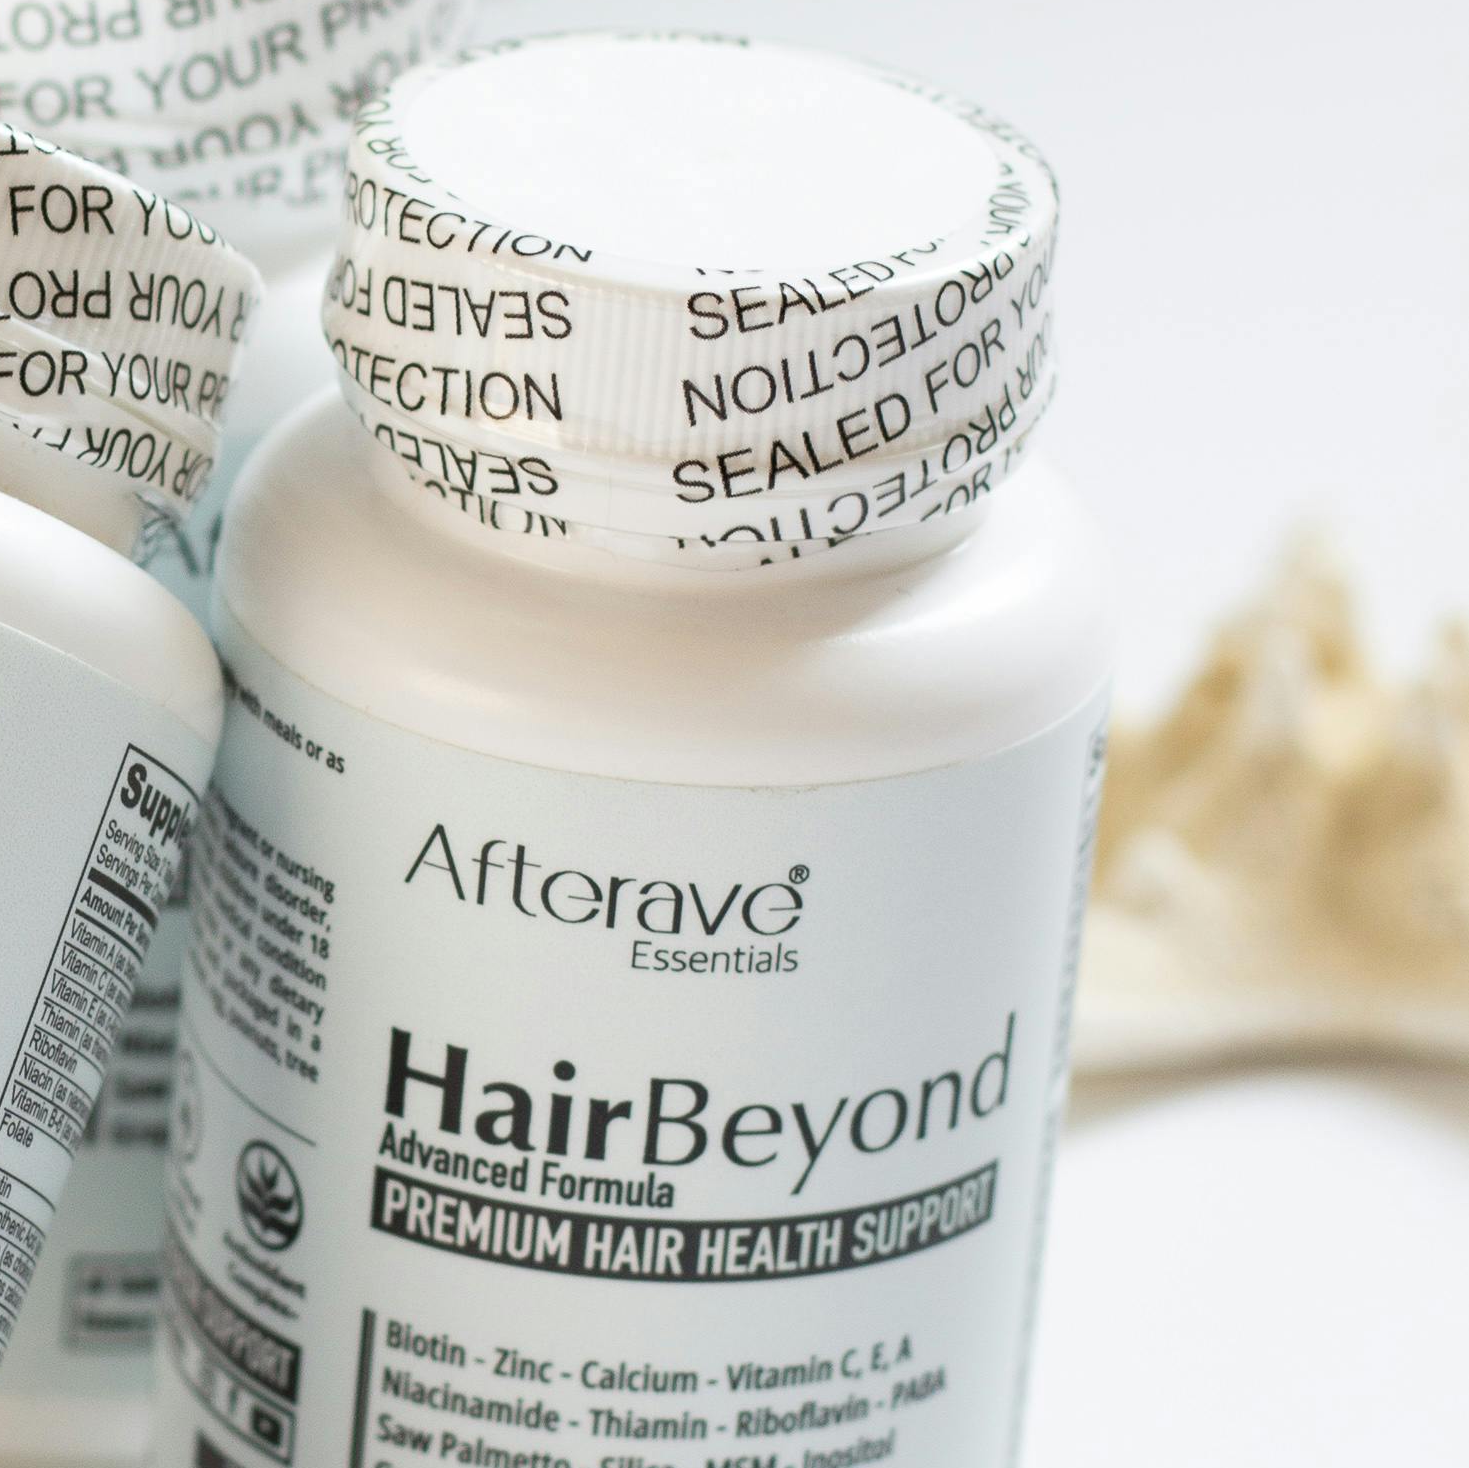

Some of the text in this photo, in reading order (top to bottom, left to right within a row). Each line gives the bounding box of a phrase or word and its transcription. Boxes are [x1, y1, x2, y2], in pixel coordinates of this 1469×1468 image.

[134, 22, 303, 113] YOUR
[8, 184, 115, 236] FOR
[347, 172, 593, 263] ROTECTION
[128, 271, 225, 338] YOUR
[382, 275, 573, 341] SEALED
[686, 261, 896, 341] SEALED
[681, 248, 1016, 428] PROTECTION
[101, 351, 192, 413] YOUR
[672, 391, 914, 504] SEALED
[924, 316, 1006, 415] FOR
[306, 739, 324, 761] or
[325, 751, 346, 774] as
[104, 818, 145, 864] Serving
[95, 842, 140, 889] Servings
[80, 885, 125, 930] Amount
[70, 917, 109, 959] Vitamin
[310, 932, 330, 961] 18
[630, 940, 800, 975] Essentials
[59, 943, 100, 986] Vitamin
[49, 971, 89, 1015] Vitamin
[40, 999, 82, 1041] Thiamin
[18, 1056, 55, 1094] Niacin
[29, 1030, 78, 1074] Riboflavin
[9, 1084, 50, 1126] Vitamin
[378, 1121, 676, 1210] Advanced Formula
[382, 1178, 571, 1268] PREMIUM
[584, 1222, 685, 1275] HAIR
[695, 1218, 844, 1277] HEALTH
[850, 1163, 997, 1261] SUPPORT
[385, 1319, 914, 1394] Biotin Zinc Calcium Vitamin C, E, A
[381, 1365, 949, 1441] Niacinamide Thiamin Riboflavin PABA
[376, 1411, 433, 1453] Saw
